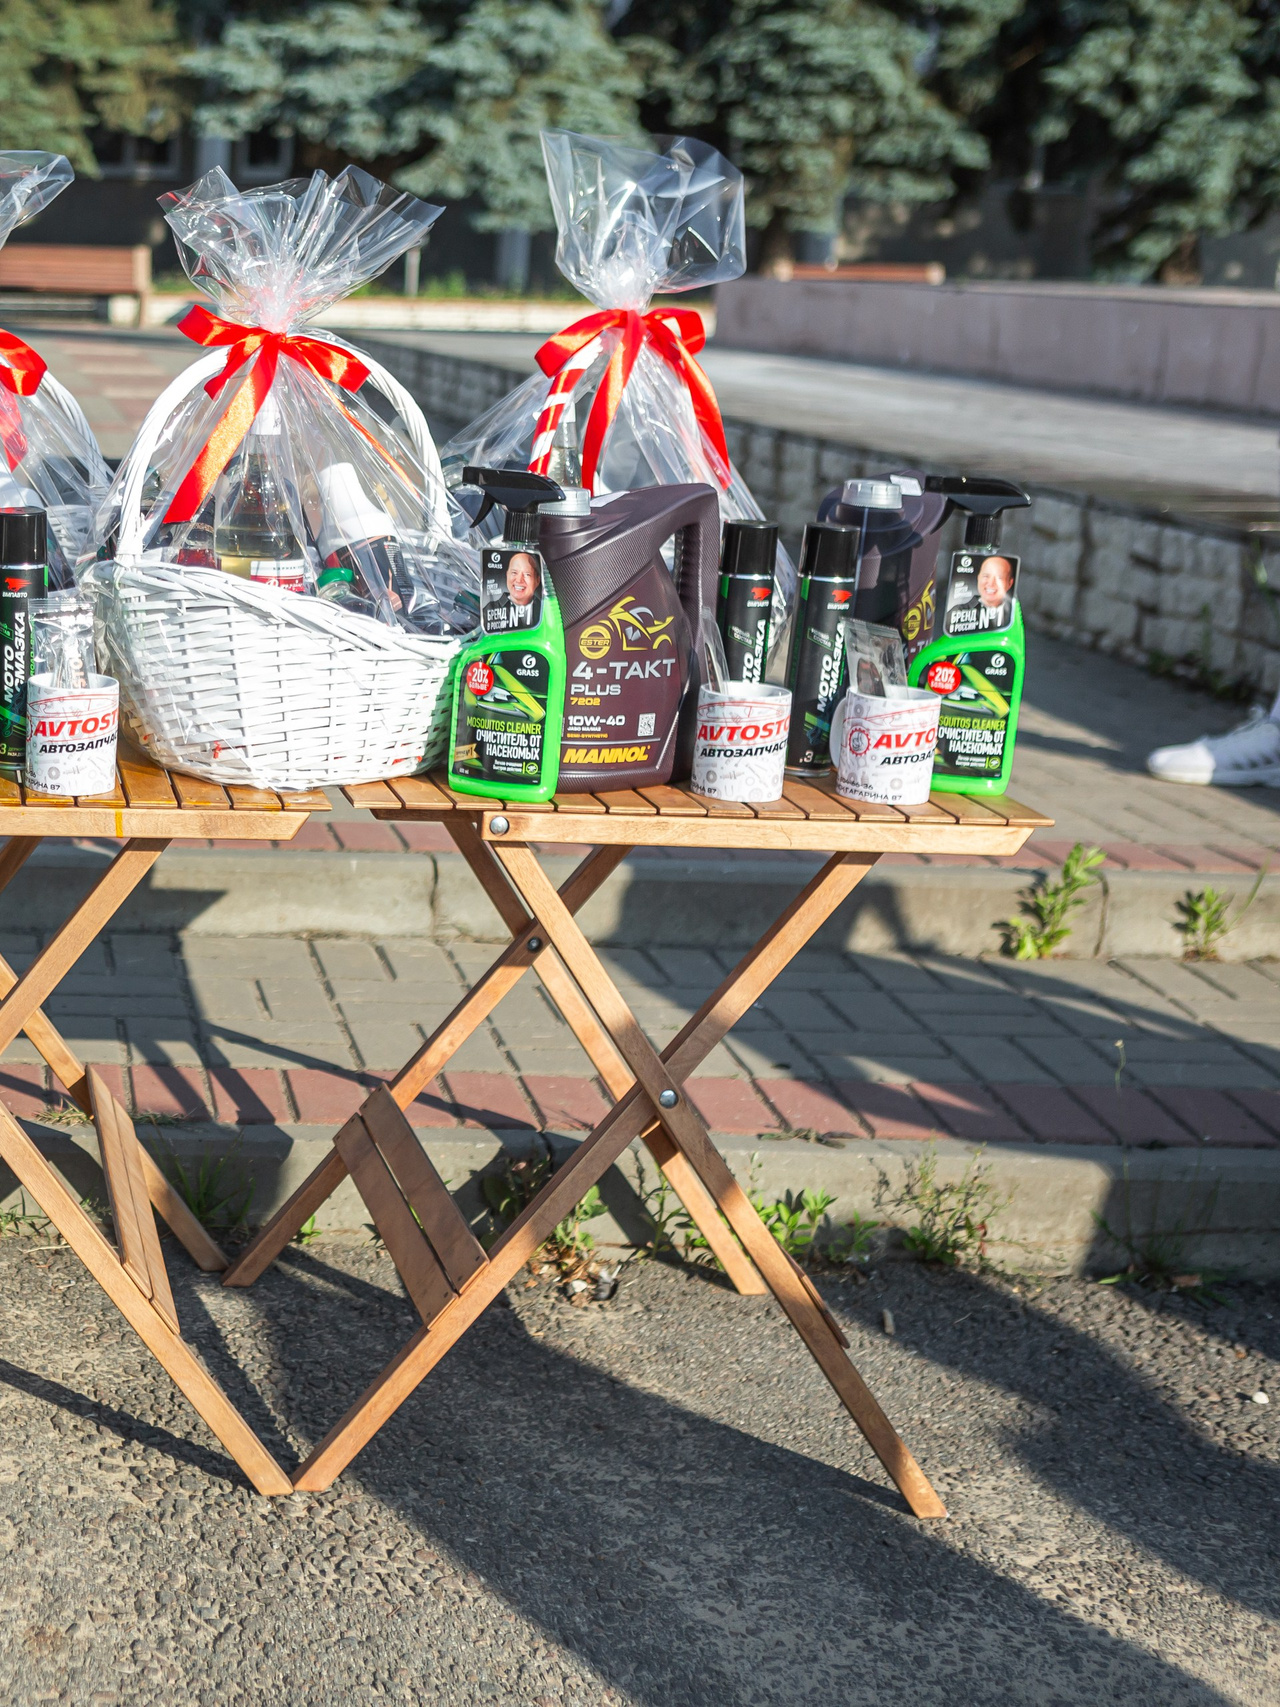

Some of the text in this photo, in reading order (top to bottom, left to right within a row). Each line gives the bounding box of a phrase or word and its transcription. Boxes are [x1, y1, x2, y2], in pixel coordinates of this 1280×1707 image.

[486, 607, 507, 622] БРЕНД
[951, 608, 977, 624] БРЕНД
[580, 638, 611, 647] ESTER
[14, 611, 26, 693] СМАЗКА
[752, 619, 766, 684] МАЗКА
[4, 645, 15, 703] МОТО
[471, 667, 489, 683] 20%
[516, 668, 540, 677] GRASS
[572, 658, 675, 680] 4-TAKT
[934, 666, 956, 683] 20%
[985, 667, 1008, 676] GRASS
[570, 684, 621, 696] PLUS
[817, 654, 833, 712] МОТО
[570, 697, 601, 706] 7202
[466, 715, 542, 735] MOSQUITOS CLEANER
[567, 715, 626, 726] 10W-40
[939, 715, 1006, 731] SQUITOS CLEANER
[475, 729, 542, 748] ОЧИСТИТЕЛЬ ОТ
[938, 726, 1006, 743] ОЧИСТИТЕЛЬ ОТ
[486, 743, 540, 760] НАСЕКОМЫХ
[562, 746, 651, 764] MANNOL
[948, 741, 1004, 756] НАСЕКОМЫХ
